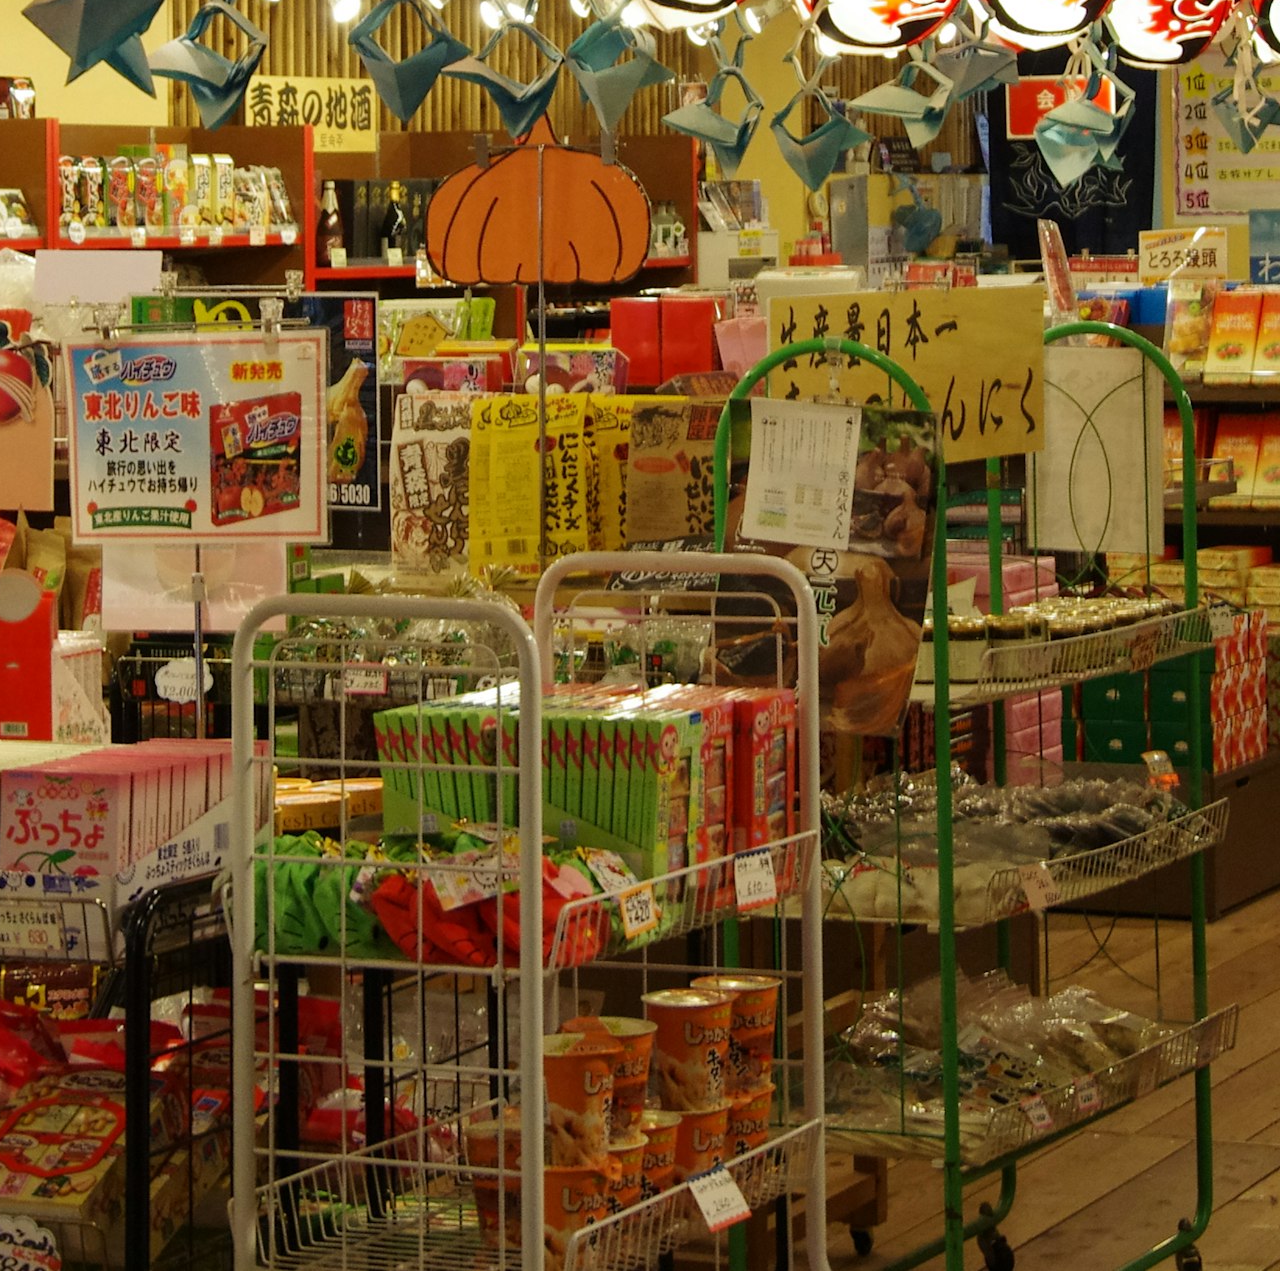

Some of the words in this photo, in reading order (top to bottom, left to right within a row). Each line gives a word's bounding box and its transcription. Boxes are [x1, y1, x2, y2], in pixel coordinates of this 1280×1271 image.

[1187, 75, 1205, 90] 1位
[249, 81, 371, 131] 青森の地酒
[1186, 104, 1207, 120] 2位
[1187, 134, 1208, 150] 3位
[1184, 163, 1208, 179] 4位
[1187, 192, 1209, 208] 5位
[1148, 246, 1218, 269] とろろ饅頭
[231, 362, 283, 380] 新発売
[83, 391, 201, 421] 東北りんご味
[95, 427, 183, 456] 東北限定
[106, 460, 176, 475] 旅行の思い出を
[88, 477, 199, 494] ハイチュウでお持ち帰り
[94, 510, 190, 527] 東北産りんご果汁使用
[6, 809, 105, 849] ぷっちょ
